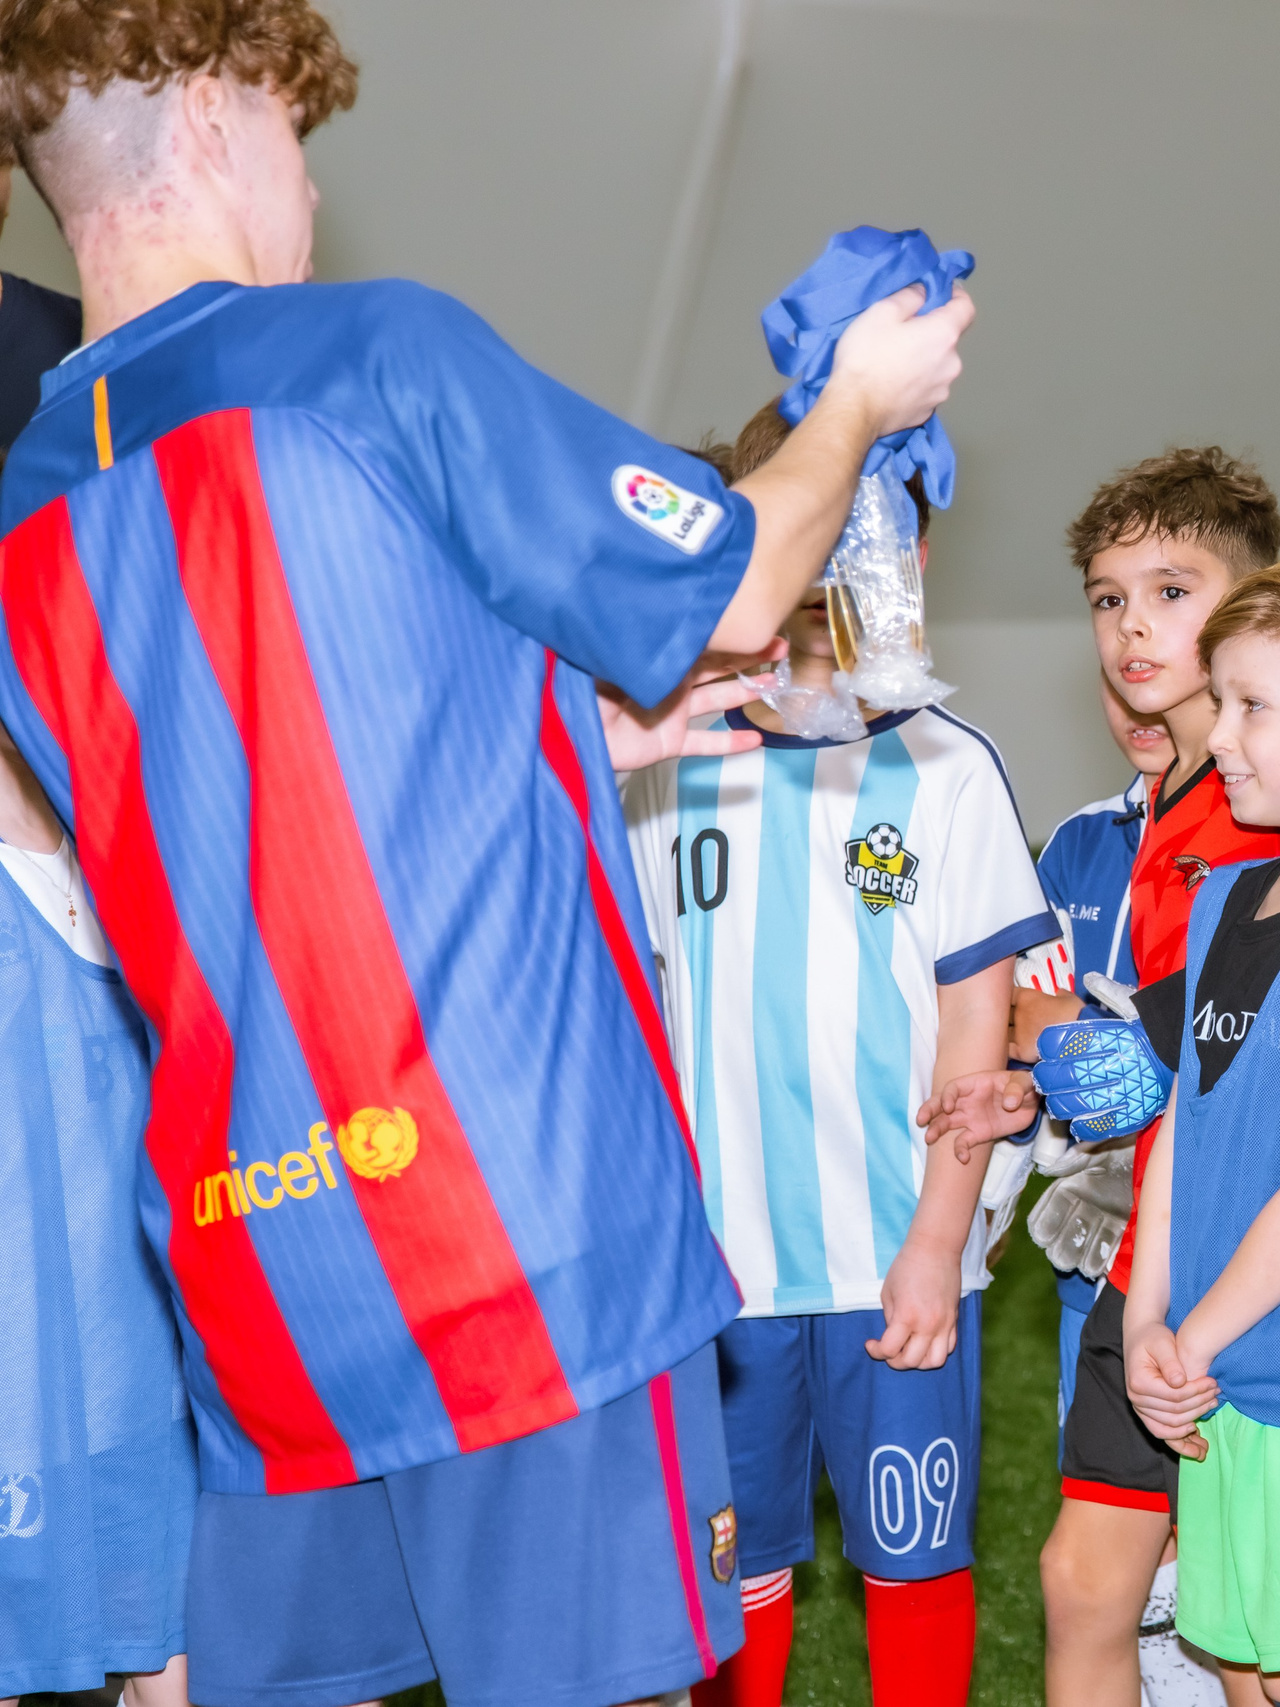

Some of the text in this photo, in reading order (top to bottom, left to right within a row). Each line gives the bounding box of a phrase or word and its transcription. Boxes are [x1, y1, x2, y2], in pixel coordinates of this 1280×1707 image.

[671, 828, 729, 918] 10
[846, 860, 918, 905] SOCCER
[874, 859, 888, 870] TEAM
[193, 1121, 338, 1227] unicef
[869, 1437, 959, 1555] 09
